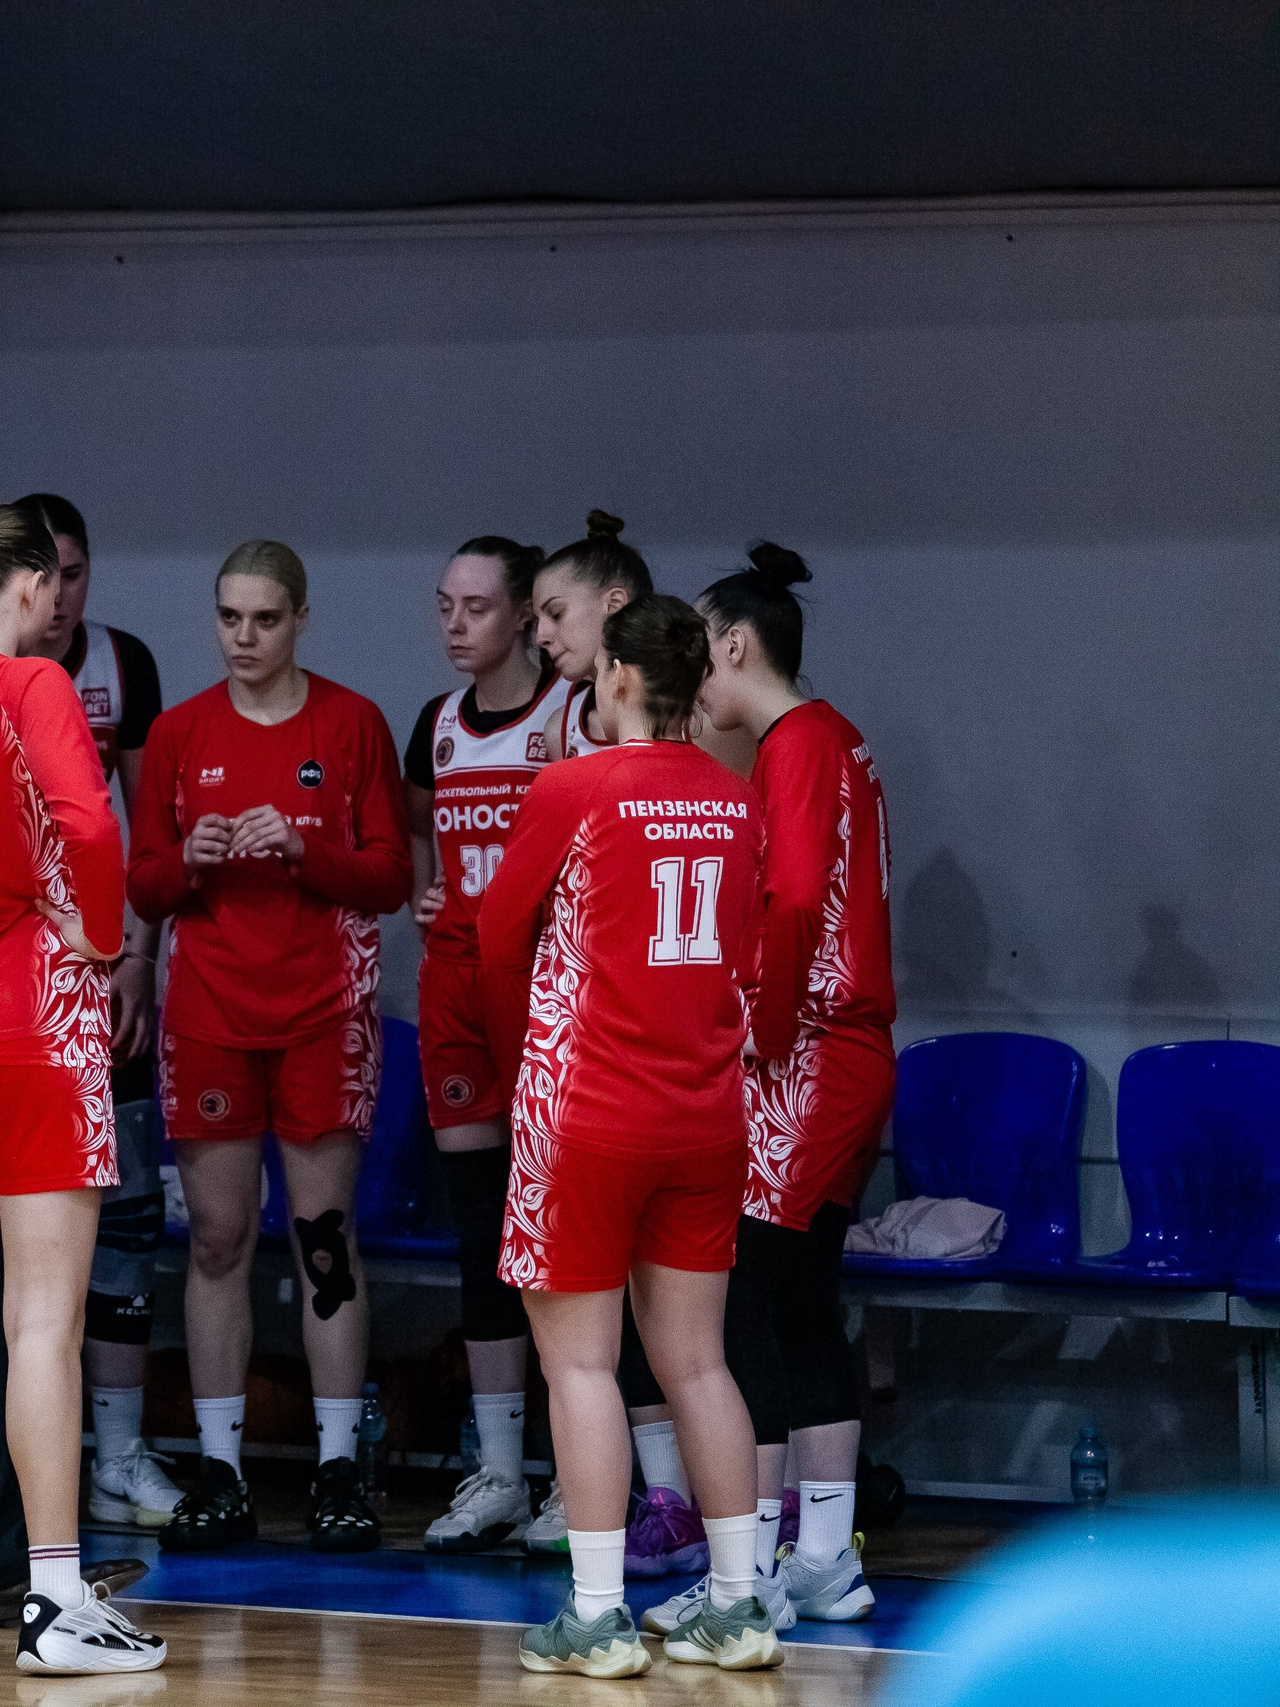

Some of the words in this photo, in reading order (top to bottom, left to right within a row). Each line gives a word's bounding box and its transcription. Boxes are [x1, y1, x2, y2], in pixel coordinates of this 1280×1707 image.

[529, 735, 546, 747] FO
[527, 746, 548, 759] BE
[515, 785, 531, 795] КЛ
[618, 800, 748, 819] ПЕНЗЕНСКАЯ
[644, 823, 734, 840] ОБЛАСТЬ
[647, 856, 724, 967] 11
[116, 1307, 152, 1315] KELM
